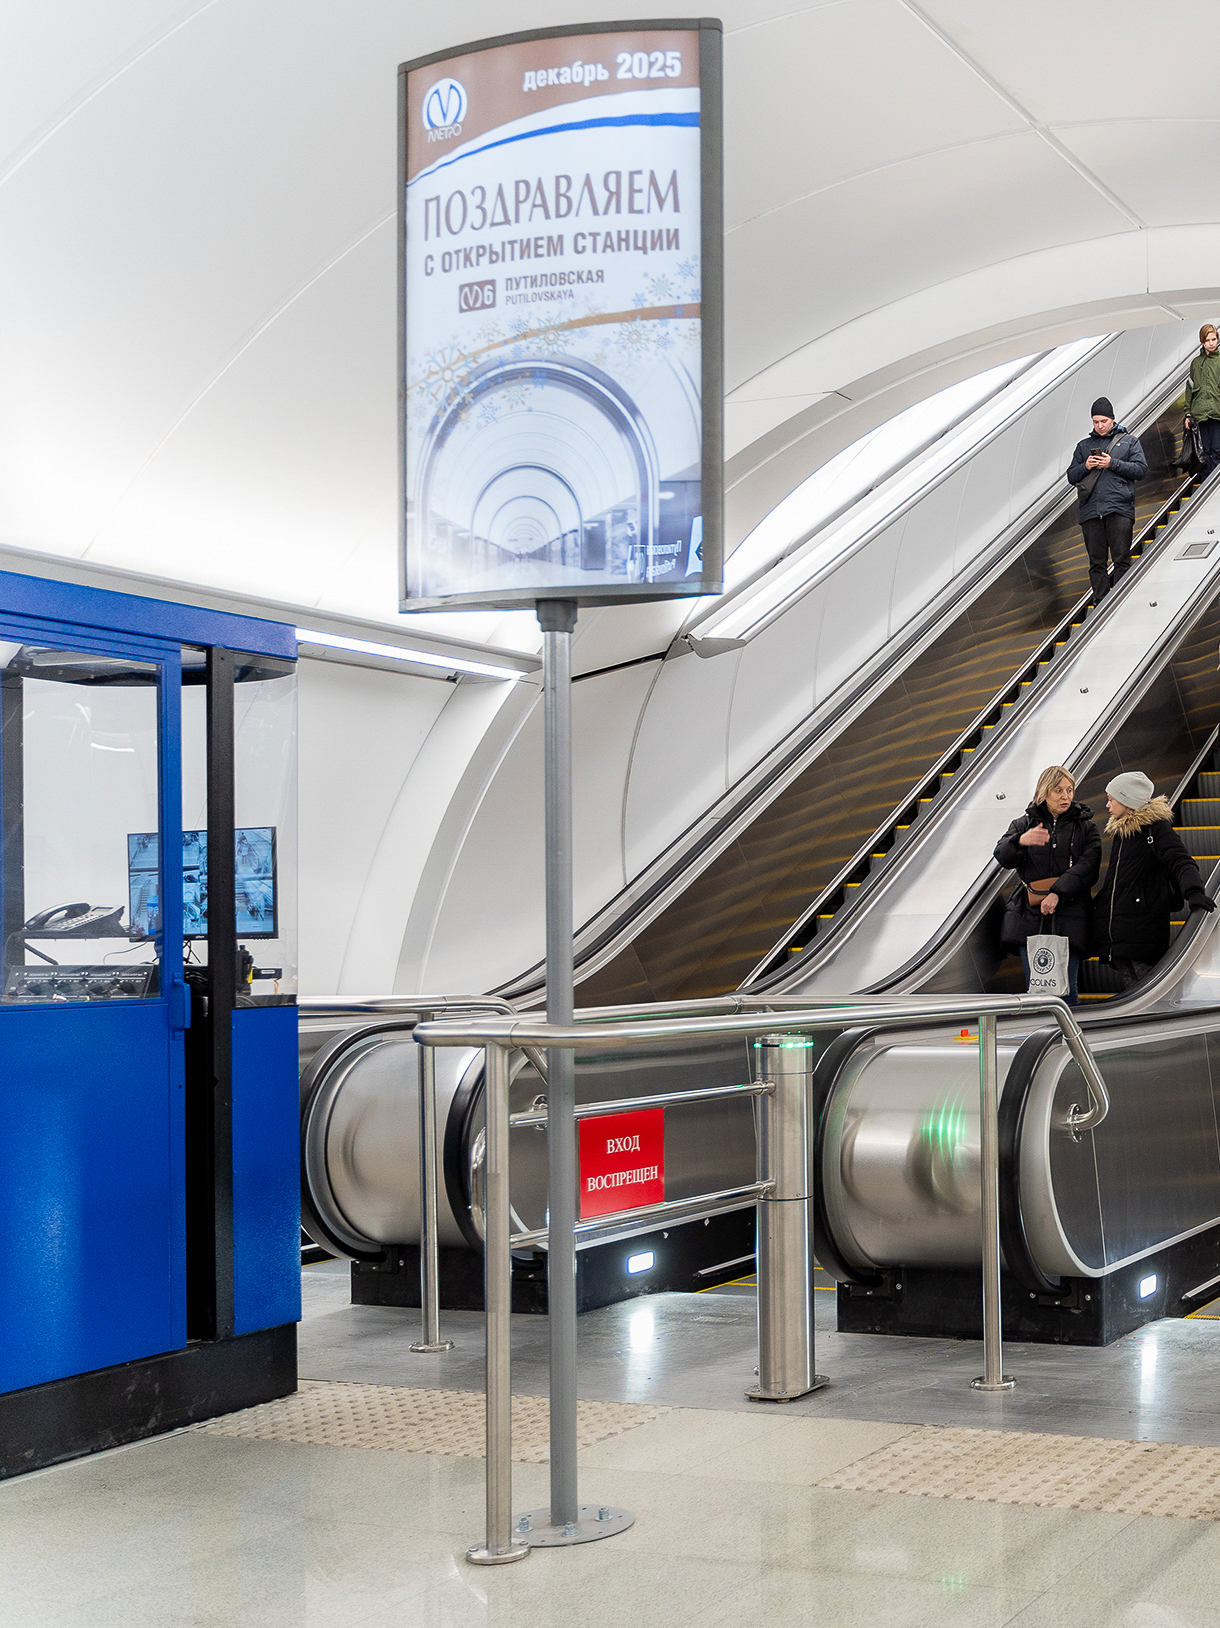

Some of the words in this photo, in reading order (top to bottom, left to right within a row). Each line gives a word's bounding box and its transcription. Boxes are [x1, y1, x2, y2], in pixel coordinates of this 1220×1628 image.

[522, 60, 609, 92] декабрь
[615, 51, 682, 80] 2025
[427, 122, 462, 143] МЕТРО
[424, 169, 681, 242] ПОЗДРАВЛЯЕМ
[424, 254, 435, 277] С
[441, 234, 564, 274] ОТКРЫТИЕМ
[573, 228, 680, 255] СТАНЦИИ
[505, 269, 605, 292] ПУТИЛОВСКАЯ
[505, 289, 575, 306] PUTILOVSKAYA
[1030, 978, 1057, 987] COLIN'S
[606, 1134, 640, 1155] ВХОД
[587, 1165, 659, 1192] ВОСПРЕЩЕН
